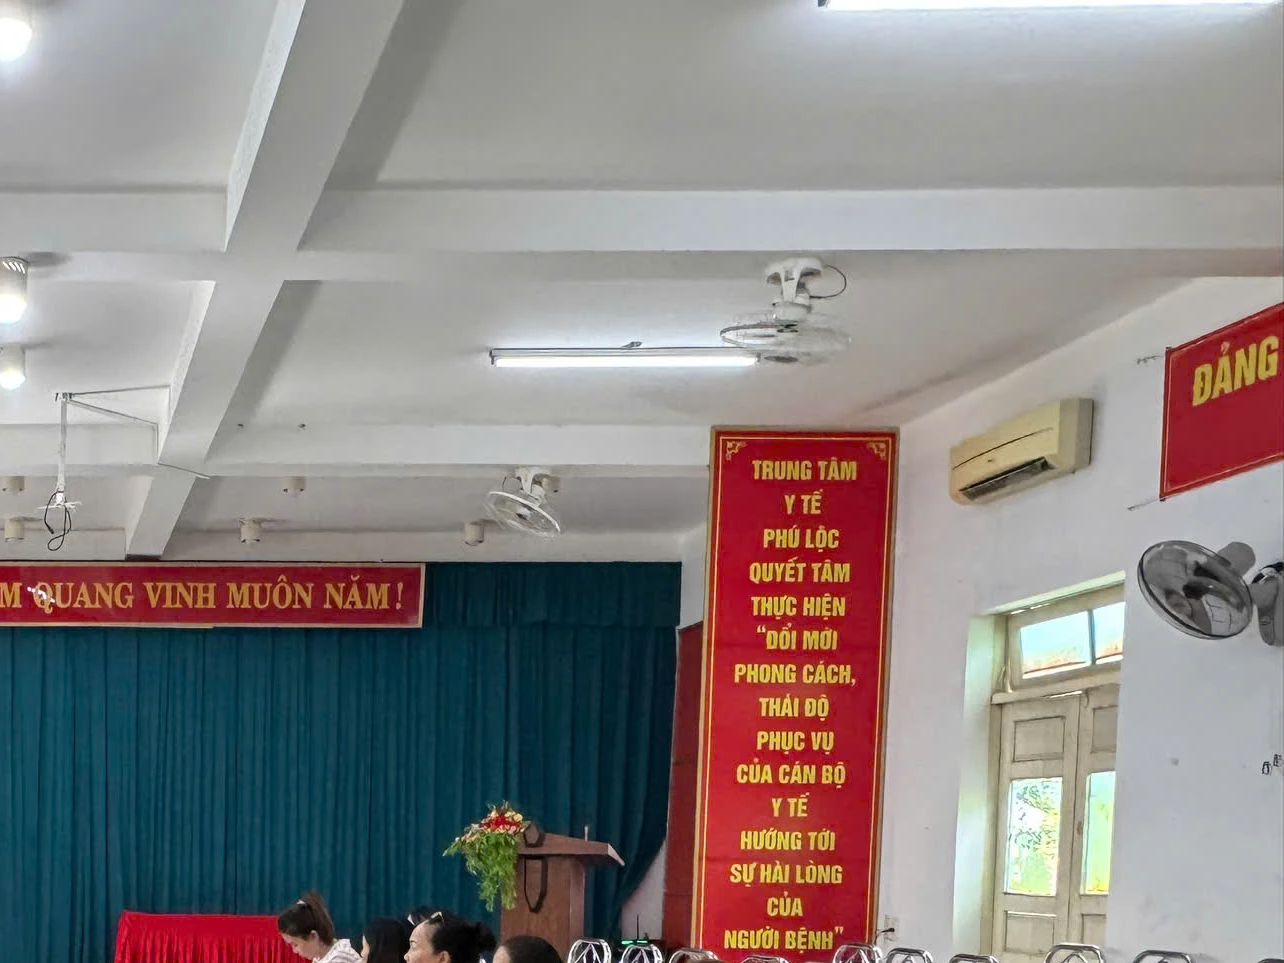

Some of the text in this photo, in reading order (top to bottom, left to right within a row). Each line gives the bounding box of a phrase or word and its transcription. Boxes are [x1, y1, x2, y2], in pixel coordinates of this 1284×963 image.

[1192, 335, 1279, 407] ĐẢNG
[752, 456, 857, 481] TRUNG TÂM
[784, 488, 824, 515] Y TẾ
[763, 524, 840, 553] PHÚ LỘC
[748, 556, 851, 585] QUYẾT TÂM
[32, 581, 134, 614] QUANG
[143, 582, 216, 609] VINH
[226, 574, 314, 610] MUÔN
[750, 594, 846, 620] THỰC HIỆN
[734, 660, 856, 686] PHONG CÁCH,
[758, 693, 829, 722] THÁI ĐỘ
[756, 731, 834, 755] PHỤC VỤ
[736, 758, 846, 789] CỦA CÁN BỘ
[772, 792, 810, 818] Y TẾ
[740, 828, 836, 851] HƯỚNG TỚI
[730, 860, 843, 887] SỰ HÀI LÒNG
[767, 891, 804, 917] CỦA
[724, 926, 845, 954] NGƯỜI BỆNH”
